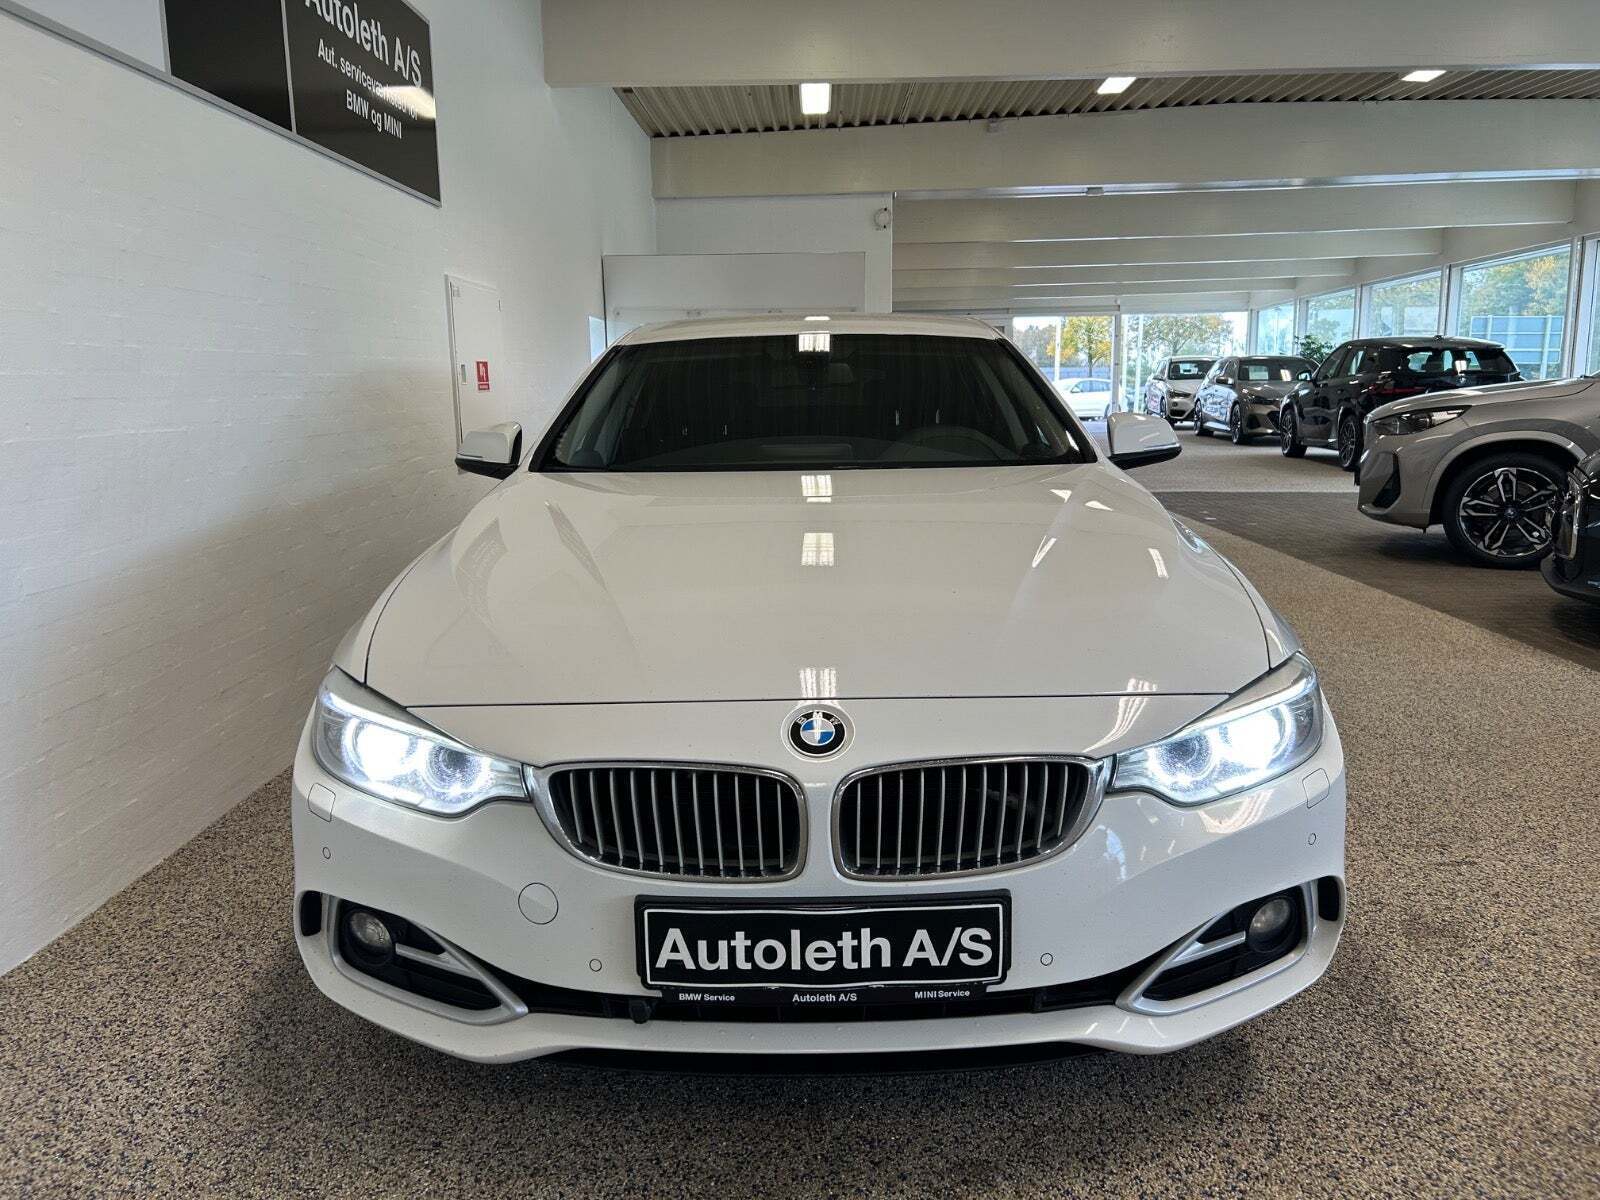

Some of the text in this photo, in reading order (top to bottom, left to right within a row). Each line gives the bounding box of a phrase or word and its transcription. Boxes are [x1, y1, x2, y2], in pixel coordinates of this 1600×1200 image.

[318, 38, 338, 69] Aut.
[394, 36, 422, 88] A/S
[346, 88, 402, 139] BMW og MINI
[655, 926, 993, 971] Autoleth A/S
[679, 993, 735, 1001] BMW Service
[792, 993, 858, 1003] Autoleth A/S
[914, 989, 970, 999] MINI Service
